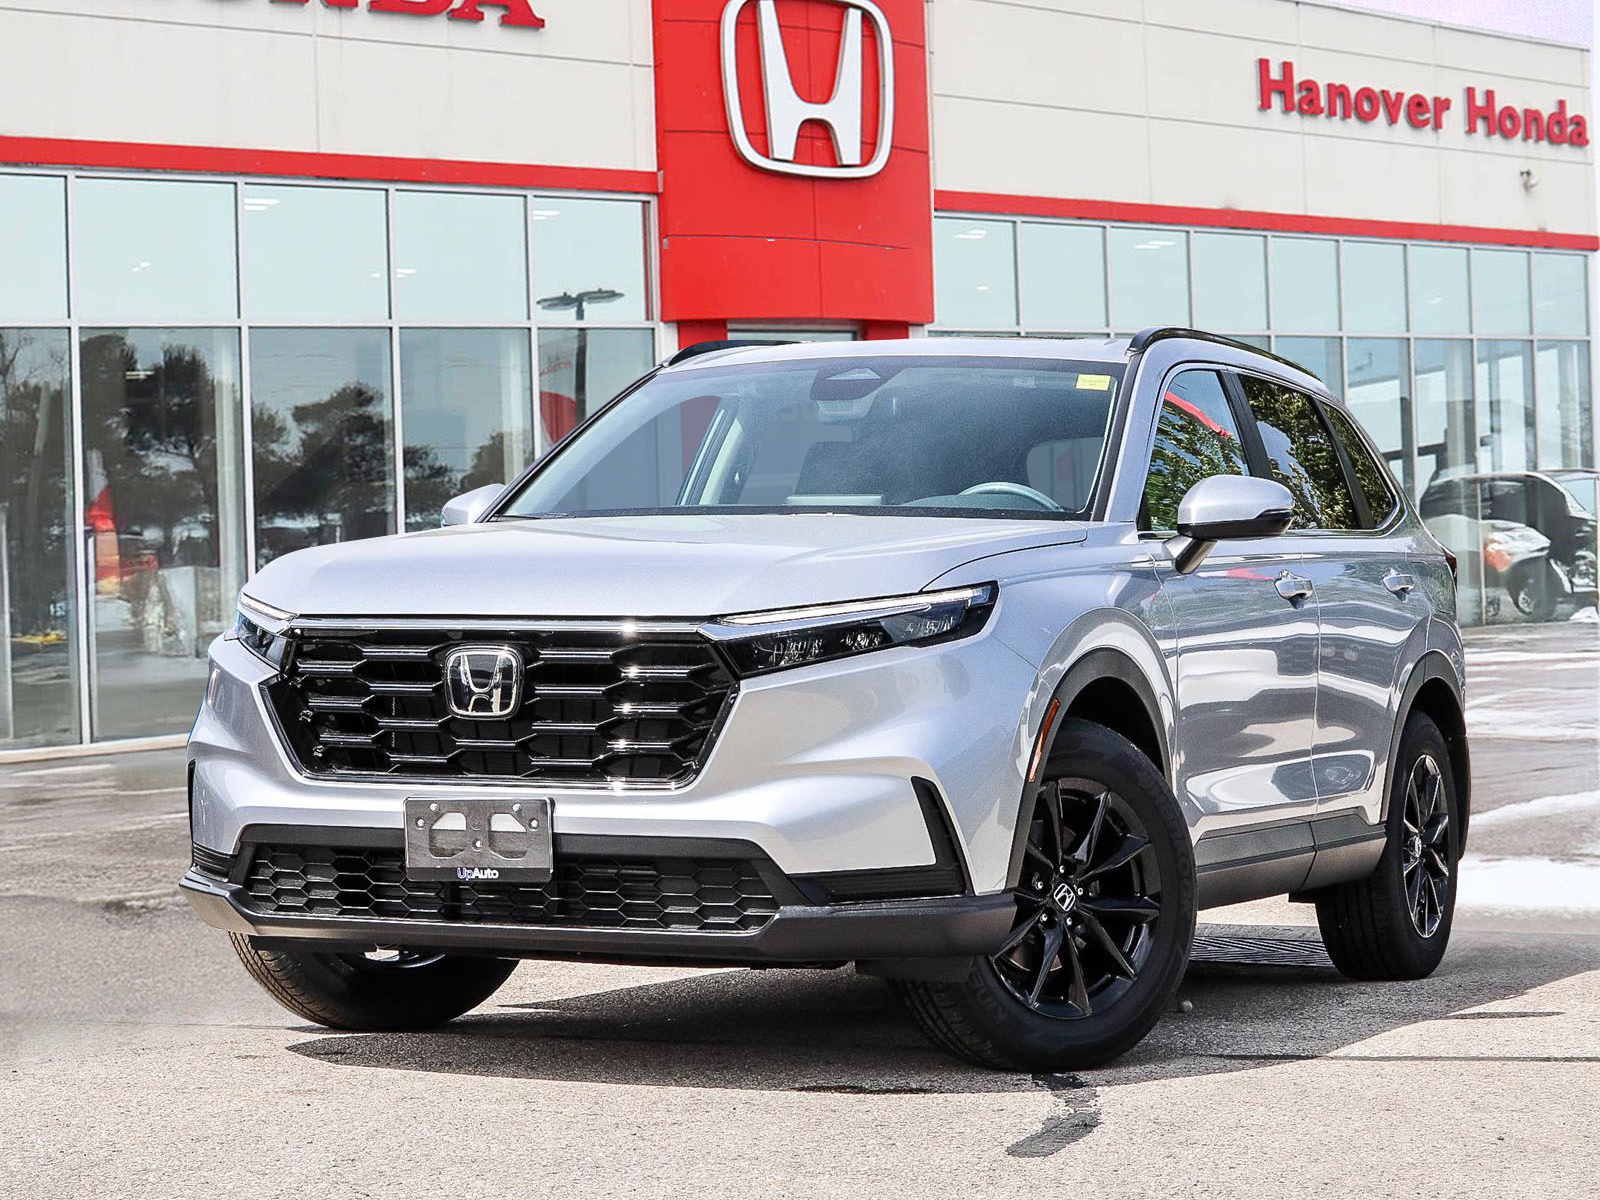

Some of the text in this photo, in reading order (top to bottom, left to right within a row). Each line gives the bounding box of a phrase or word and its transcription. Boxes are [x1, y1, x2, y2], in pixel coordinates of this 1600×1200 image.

[1257, 58, 1590, 147] Hanover Honda
[456, 867, 500, 881] UpAuto
